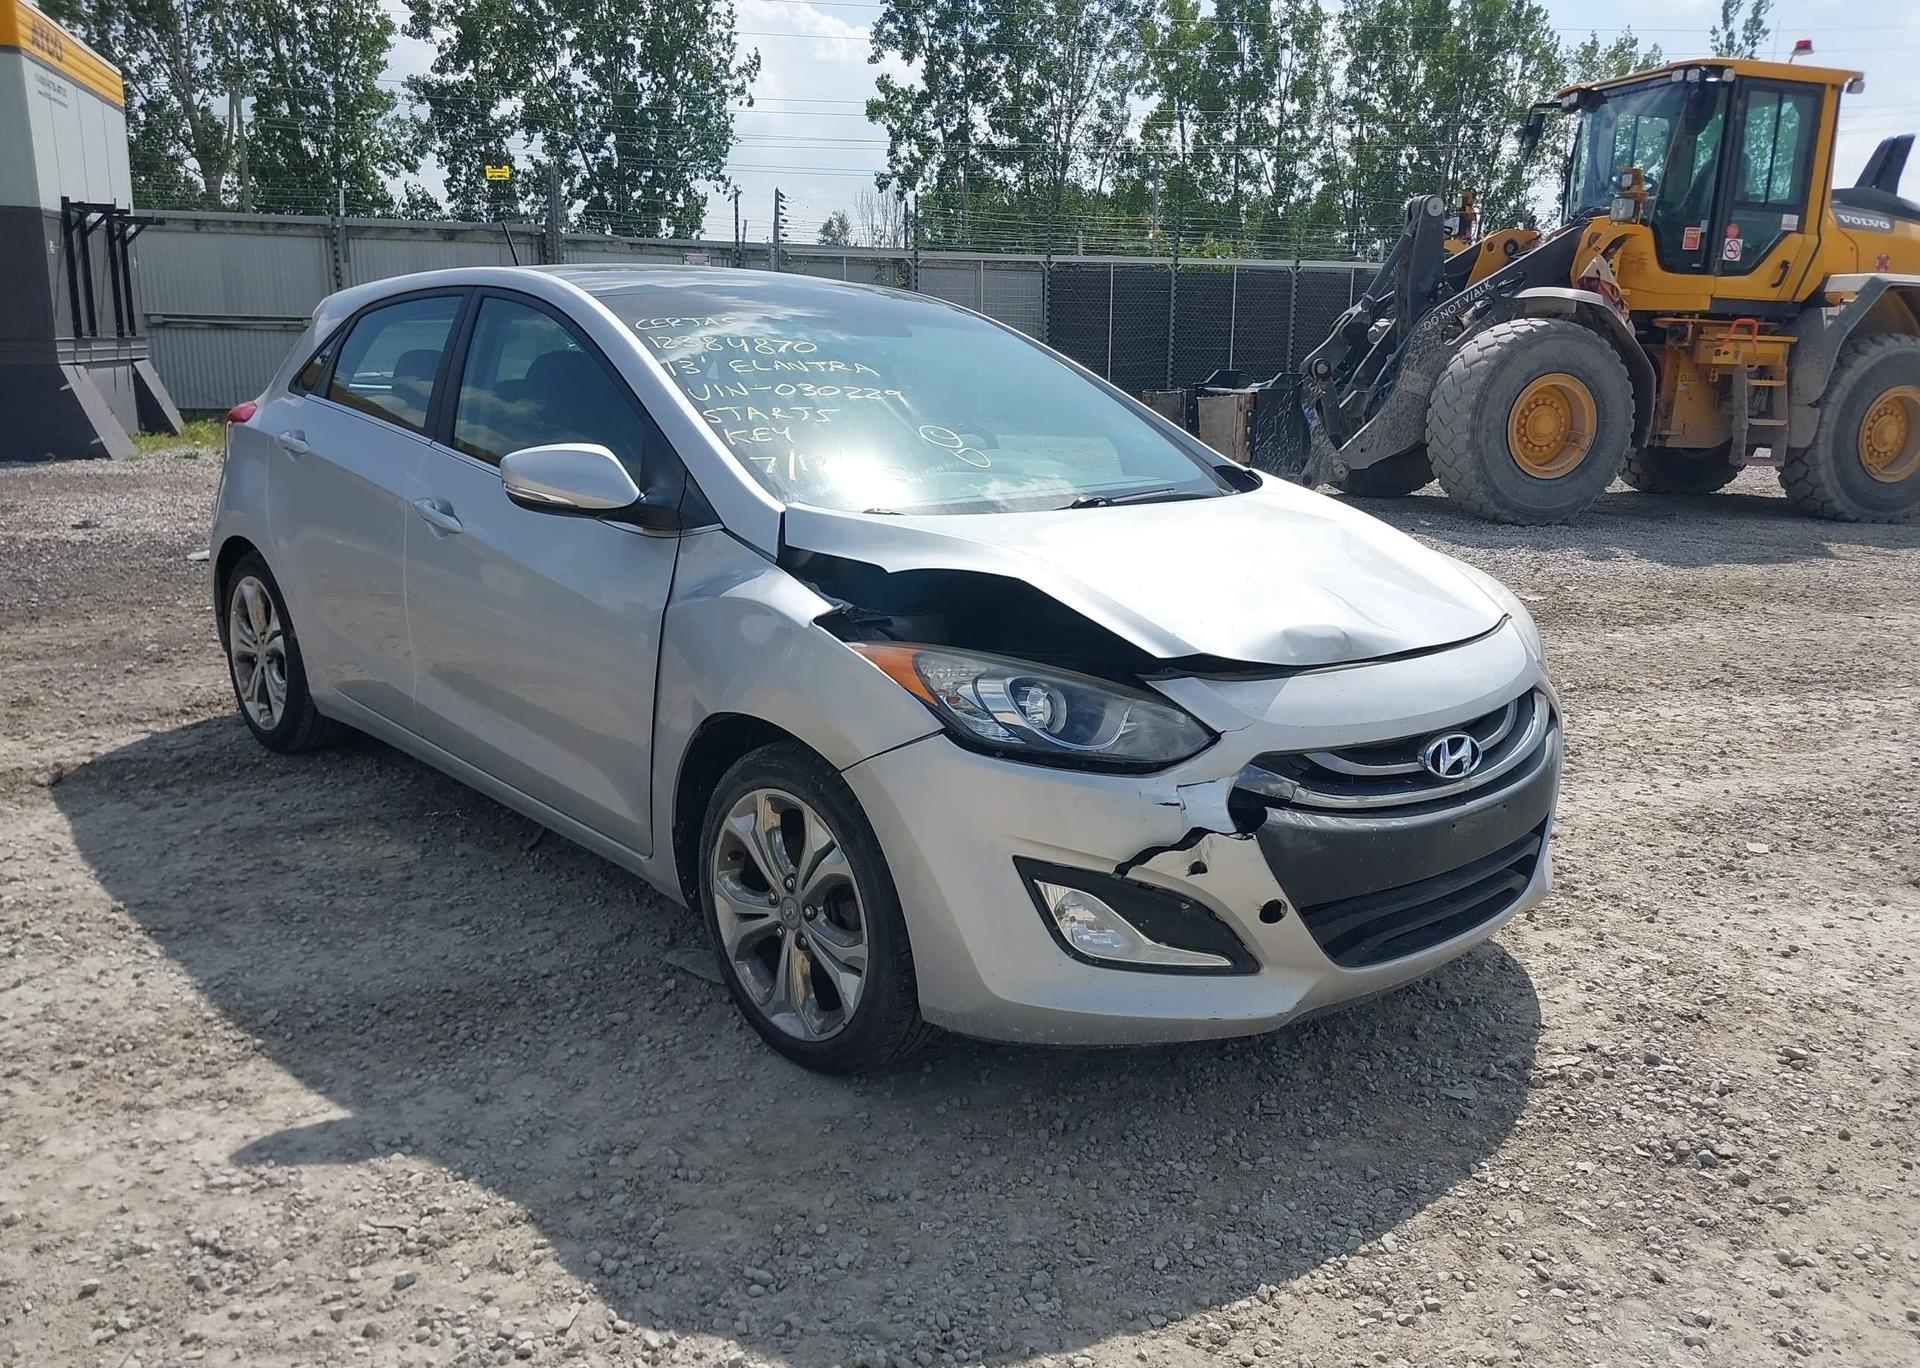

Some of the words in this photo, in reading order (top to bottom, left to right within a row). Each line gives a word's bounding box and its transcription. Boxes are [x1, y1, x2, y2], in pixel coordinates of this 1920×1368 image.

[1838, 214, 1890, 229] VOLVO
[1423, 315, 1439, 330] DO
[1440, 299, 1461, 319] NOT
[648, 335, 817, 355] 12384870
[728, 360, 881, 377] ELANTRA
[702, 406, 841, 424] STARTS
[723, 426, 796, 445] KEY
